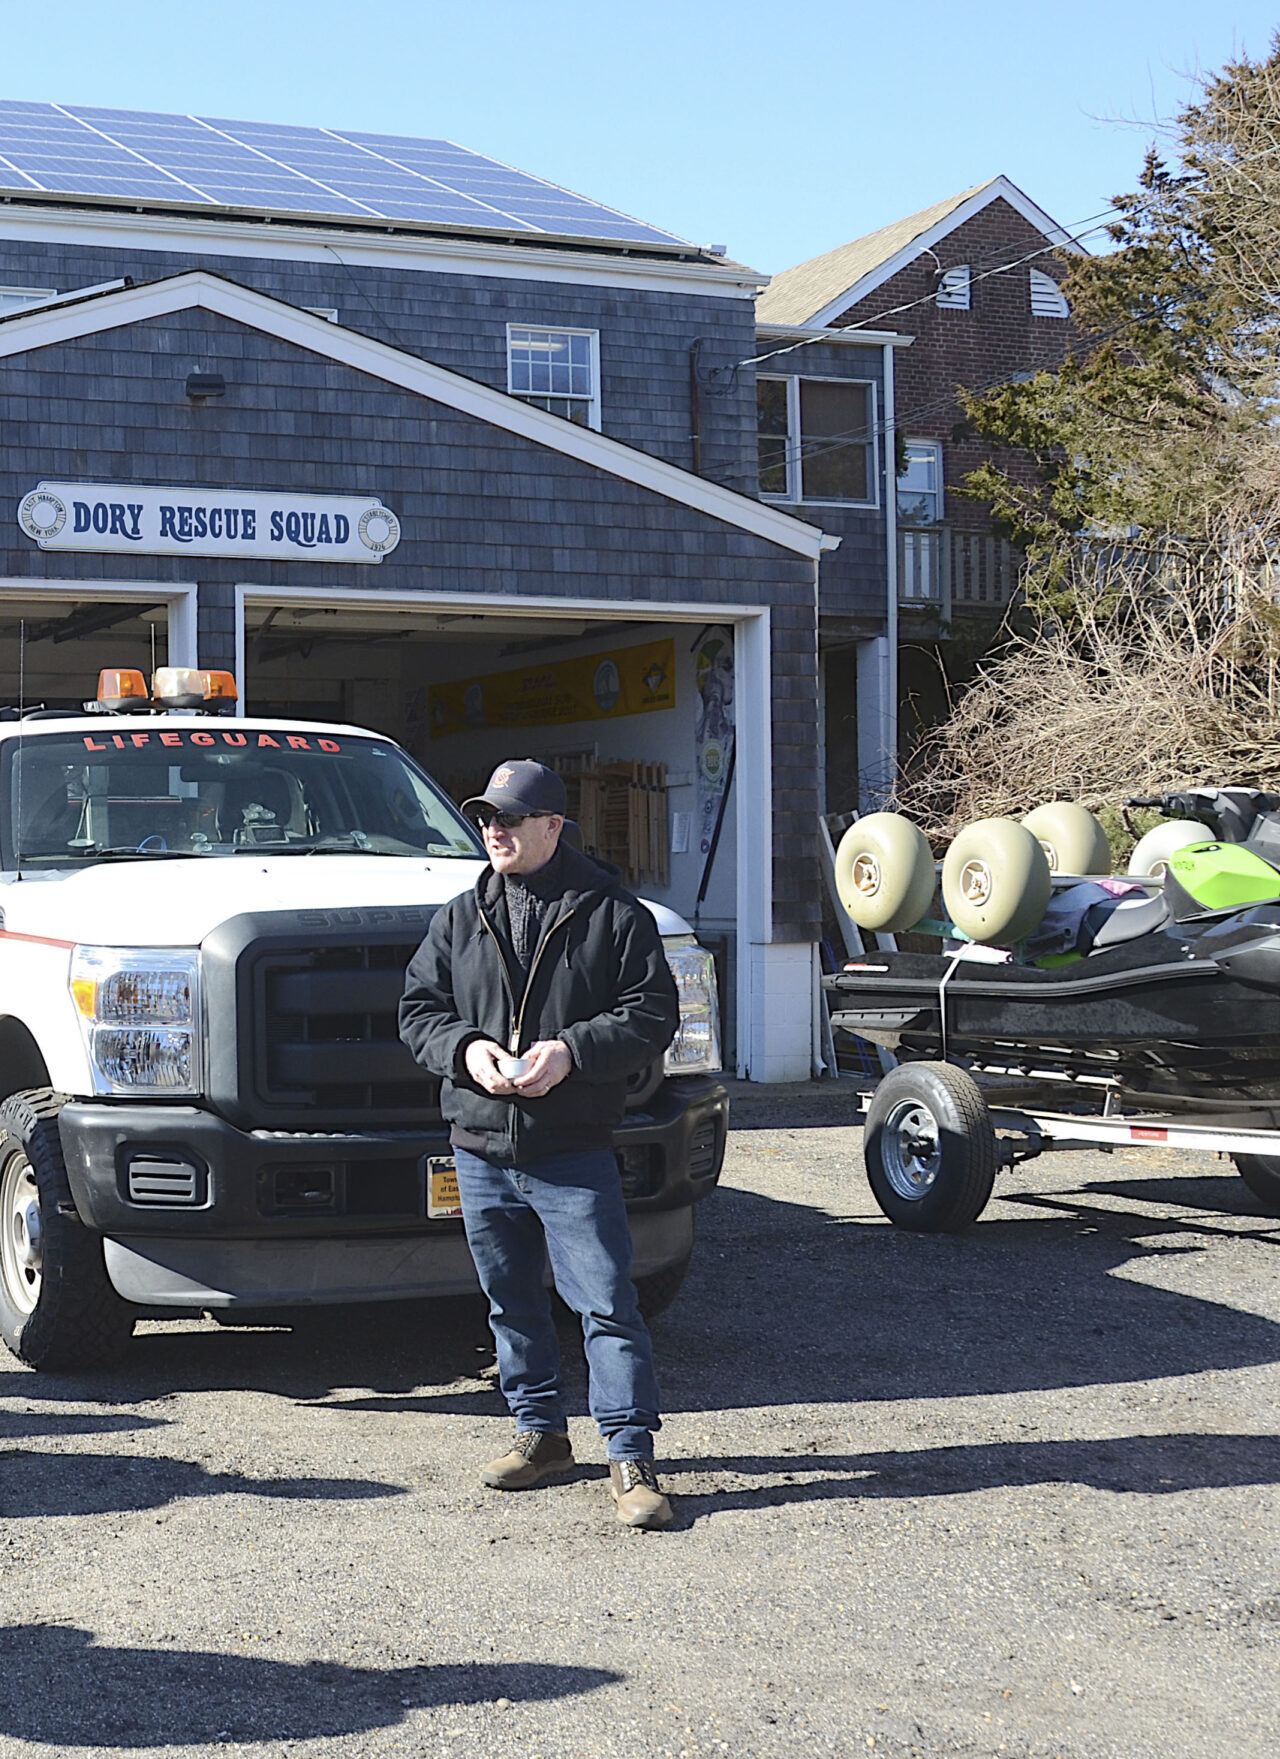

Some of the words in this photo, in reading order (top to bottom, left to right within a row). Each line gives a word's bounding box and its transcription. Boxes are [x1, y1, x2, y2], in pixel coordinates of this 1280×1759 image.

[24, 497, 36, 511] EAST
[37, 495, 63, 512] HAMPTON
[29, 524, 41, 536] NEW
[44, 525, 60, 536] YORK
[73, 501, 143, 540] DORY
[159, 506, 256, 542] RESCUE
[270, 510, 350, 547] SQUAD
[83, 732, 340, 753] LIFEGUARD
